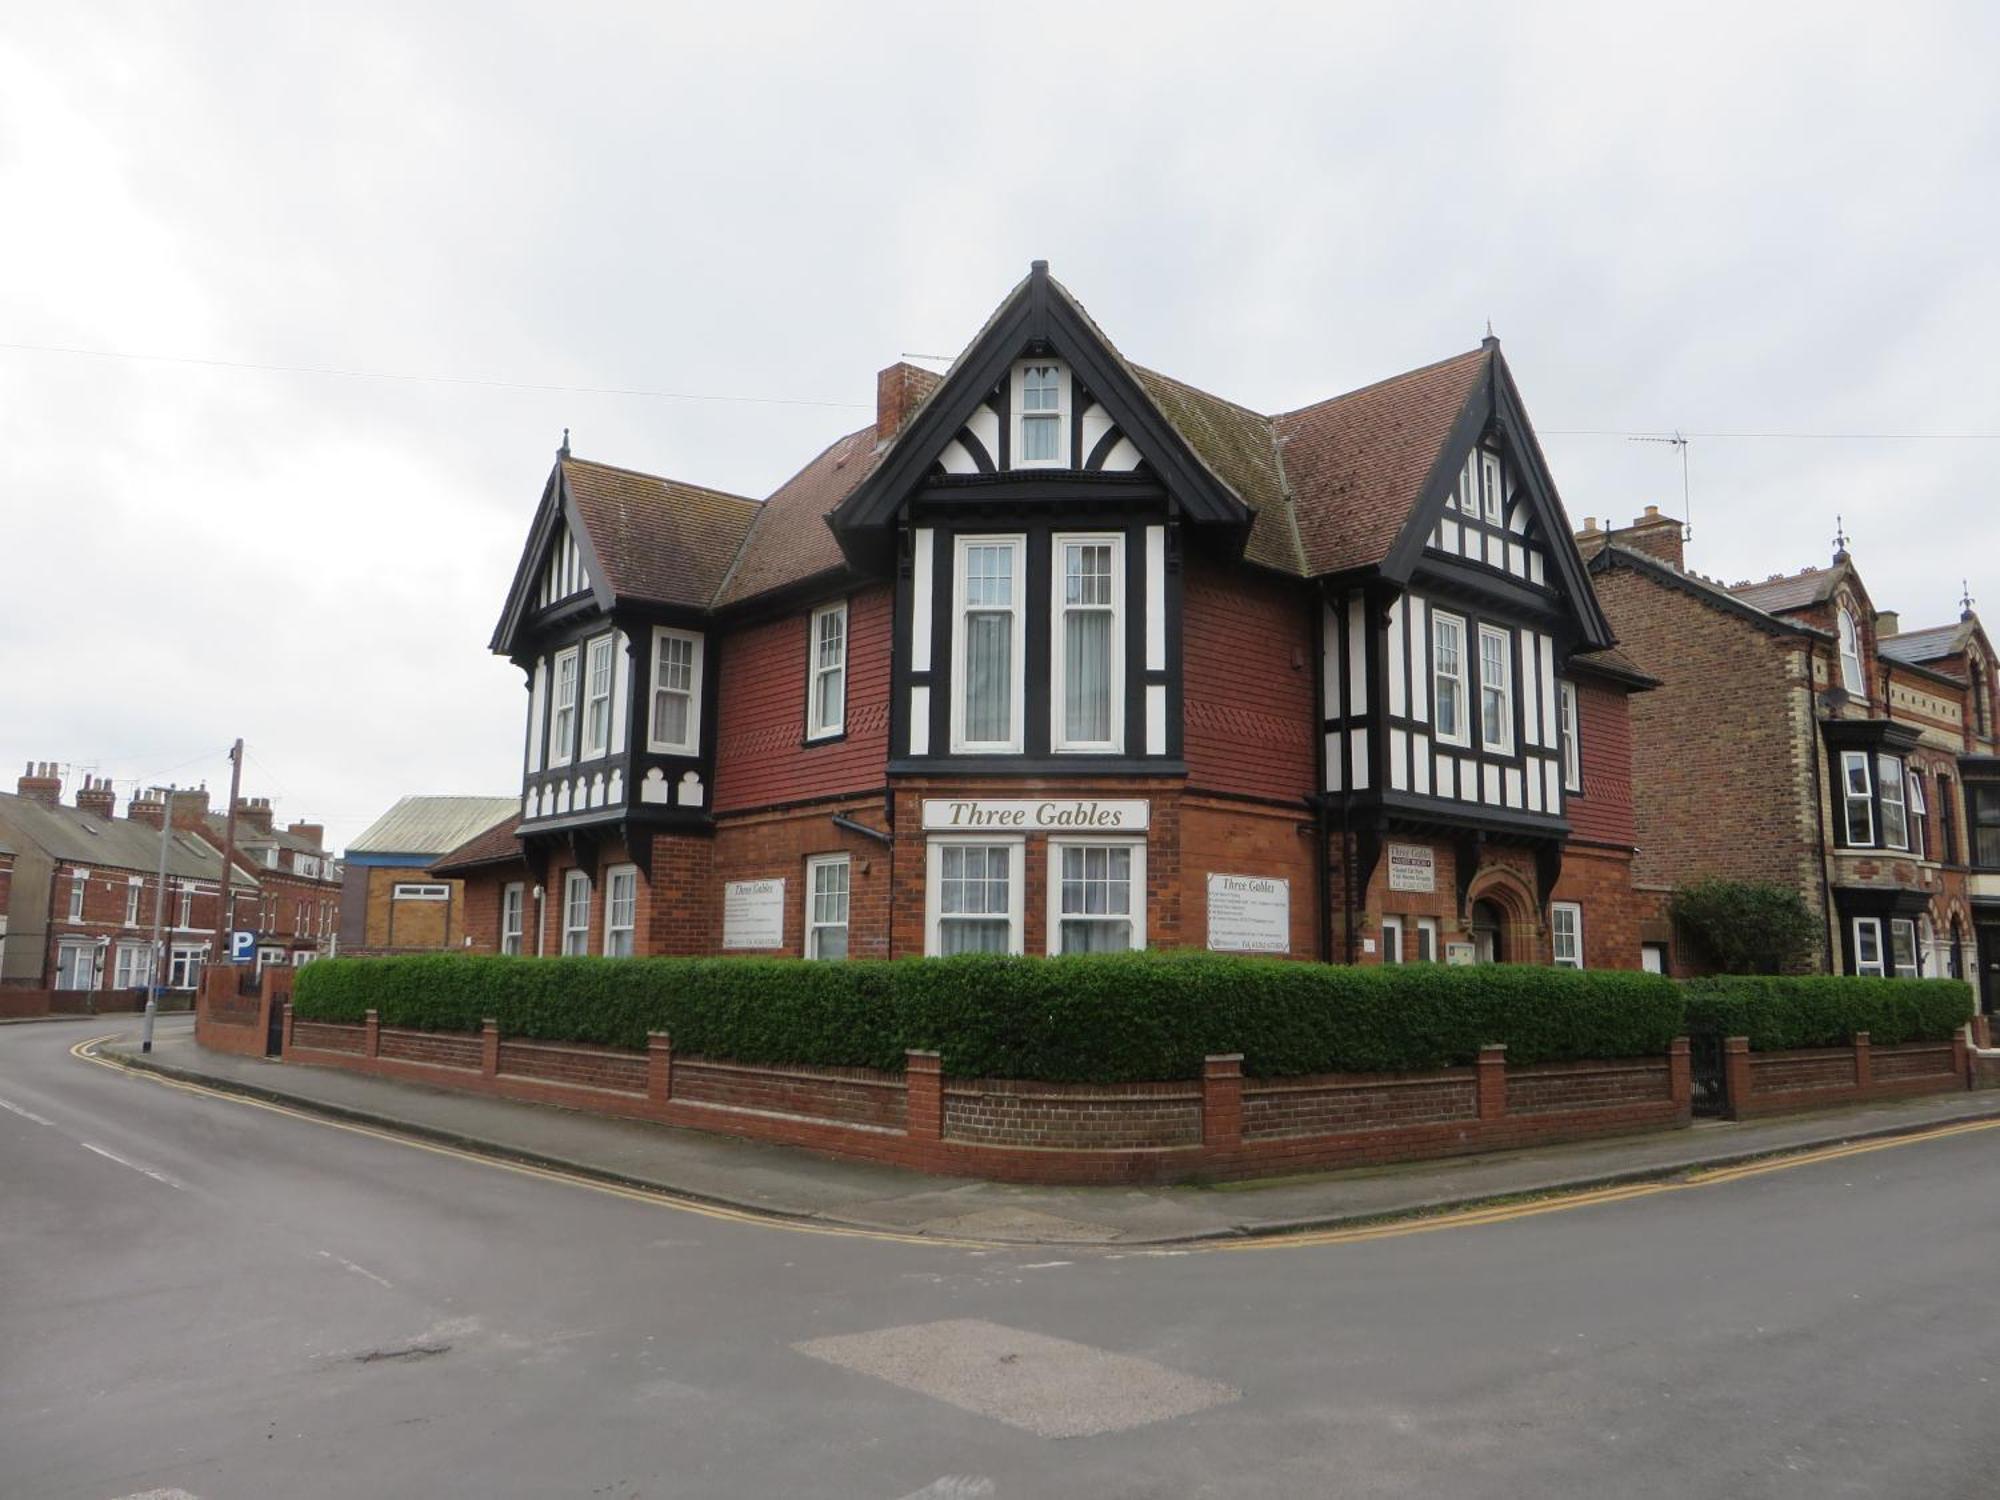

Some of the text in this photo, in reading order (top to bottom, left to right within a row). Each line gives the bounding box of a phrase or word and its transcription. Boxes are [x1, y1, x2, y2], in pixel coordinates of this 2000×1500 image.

[949, 803, 1123, 825] Three Gables
[1224, 878, 1275, 894] Three Gables
[232, 932, 254, 956] P
